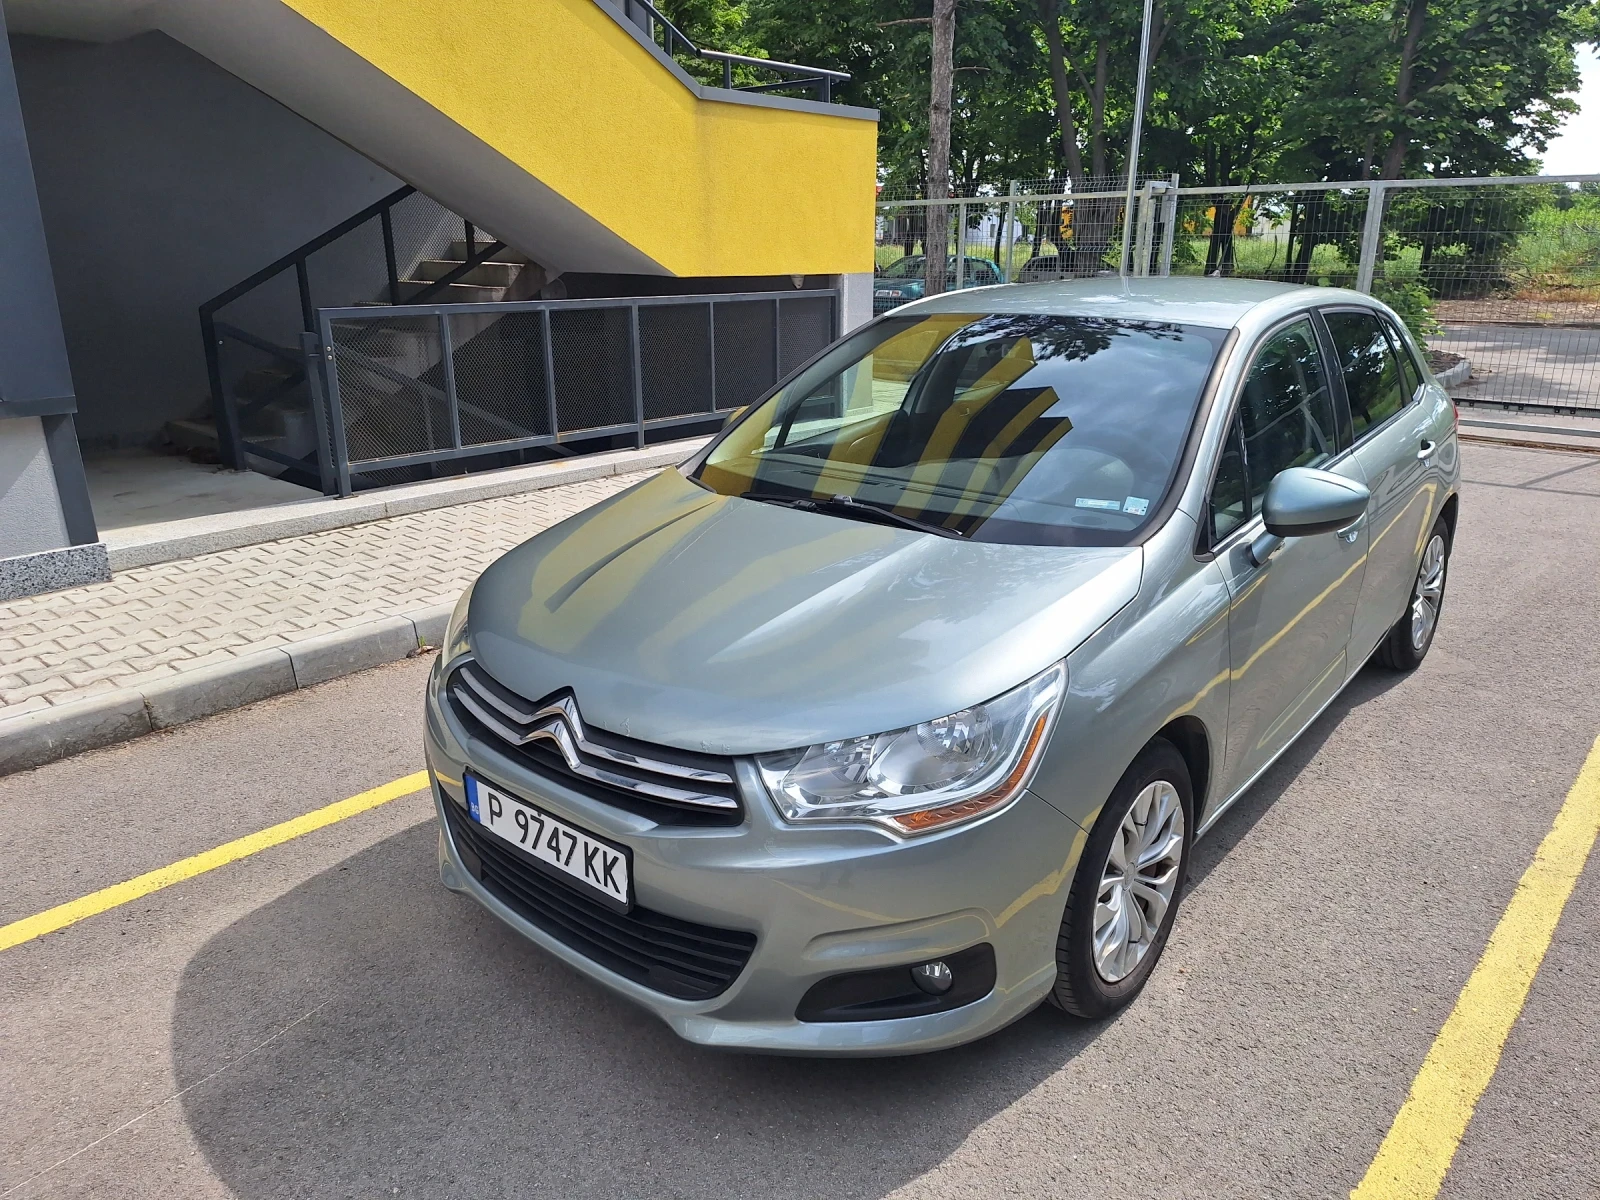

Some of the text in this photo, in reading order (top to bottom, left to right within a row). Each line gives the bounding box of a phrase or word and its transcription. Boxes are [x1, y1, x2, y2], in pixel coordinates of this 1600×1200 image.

[470, 803, 480, 815] BG
[488, 792, 621, 894] P 9747 KK
